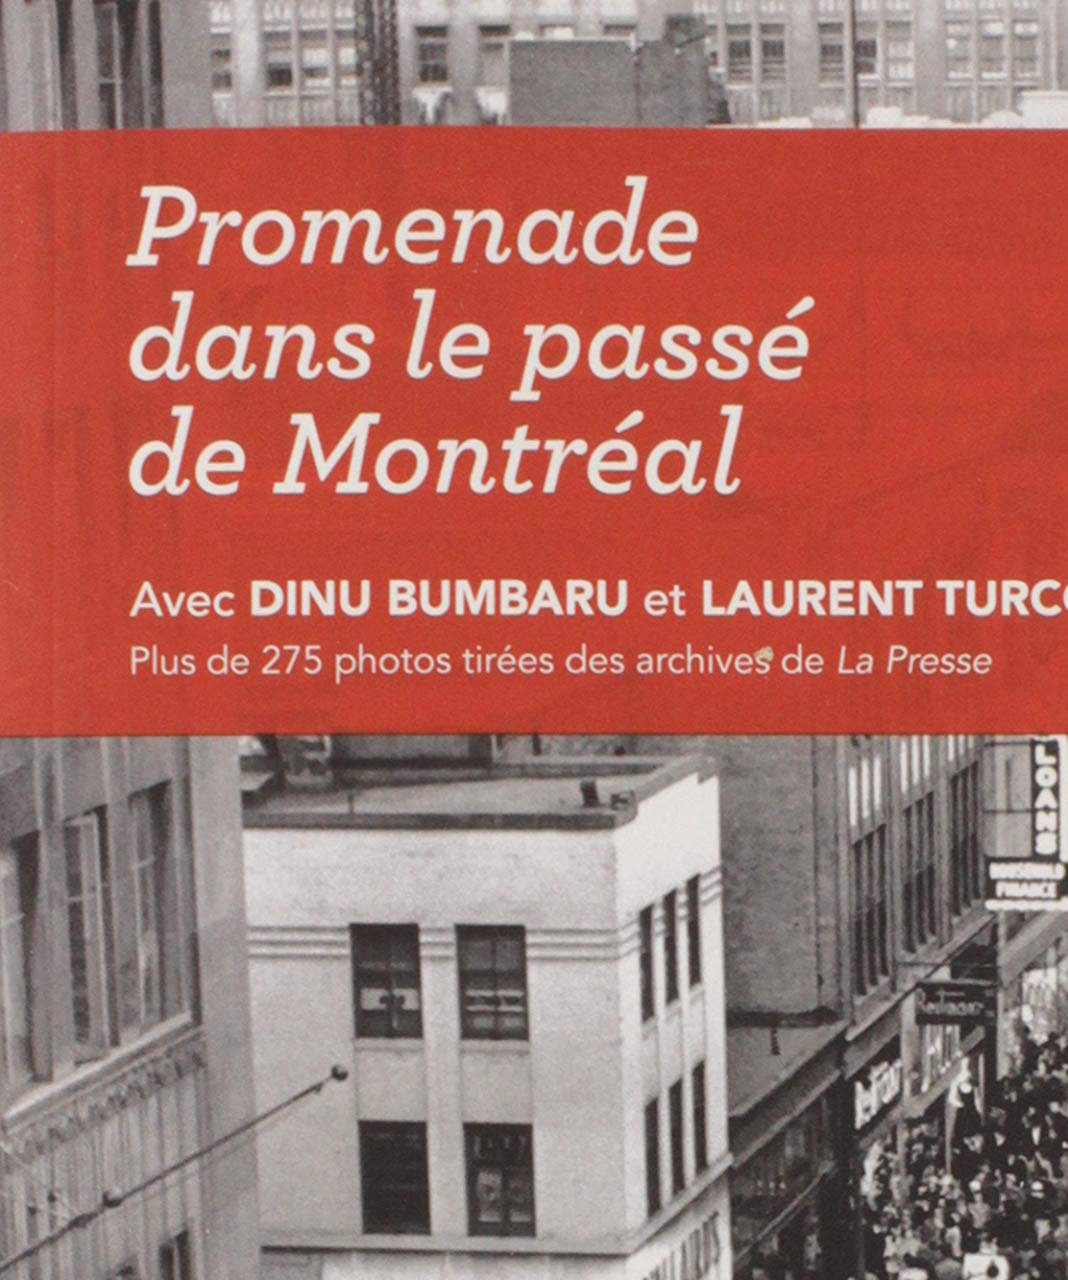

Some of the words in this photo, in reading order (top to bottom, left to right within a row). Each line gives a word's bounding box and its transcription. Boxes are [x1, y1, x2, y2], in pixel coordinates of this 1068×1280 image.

[126, 175, 699, 267] Promenade
[128, 291, 376, 382] dans
[405, 288, 491, 380] le
[509, 296, 815, 403] passé
[128, 404, 246, 497] de
[272, 404, 744, 497] Montréal
[129, 581, 235, 618] Avec
[250, 579, 371, 617] DINU
[388, 578, 628, 617] BUMBARU
[643, 584, 686, 617] et
[702, 579, 924, 617] LAURENT
[130, 644, 196, 676] Plus
[206, 643, 250, 676] de
[261, 644, 323, 675] 275
[335, 643, 452, 685] photos
[461, 643, 555, 675] tirées
[565, 642, 625, 675] des
[636, 643, 775, 675] archives
[781, 643, 825, 675] de
[838, 645, 874, 675] La
[886, 644, 993, 675] Presse
[1034, 743, 1058, 855] LOANS
